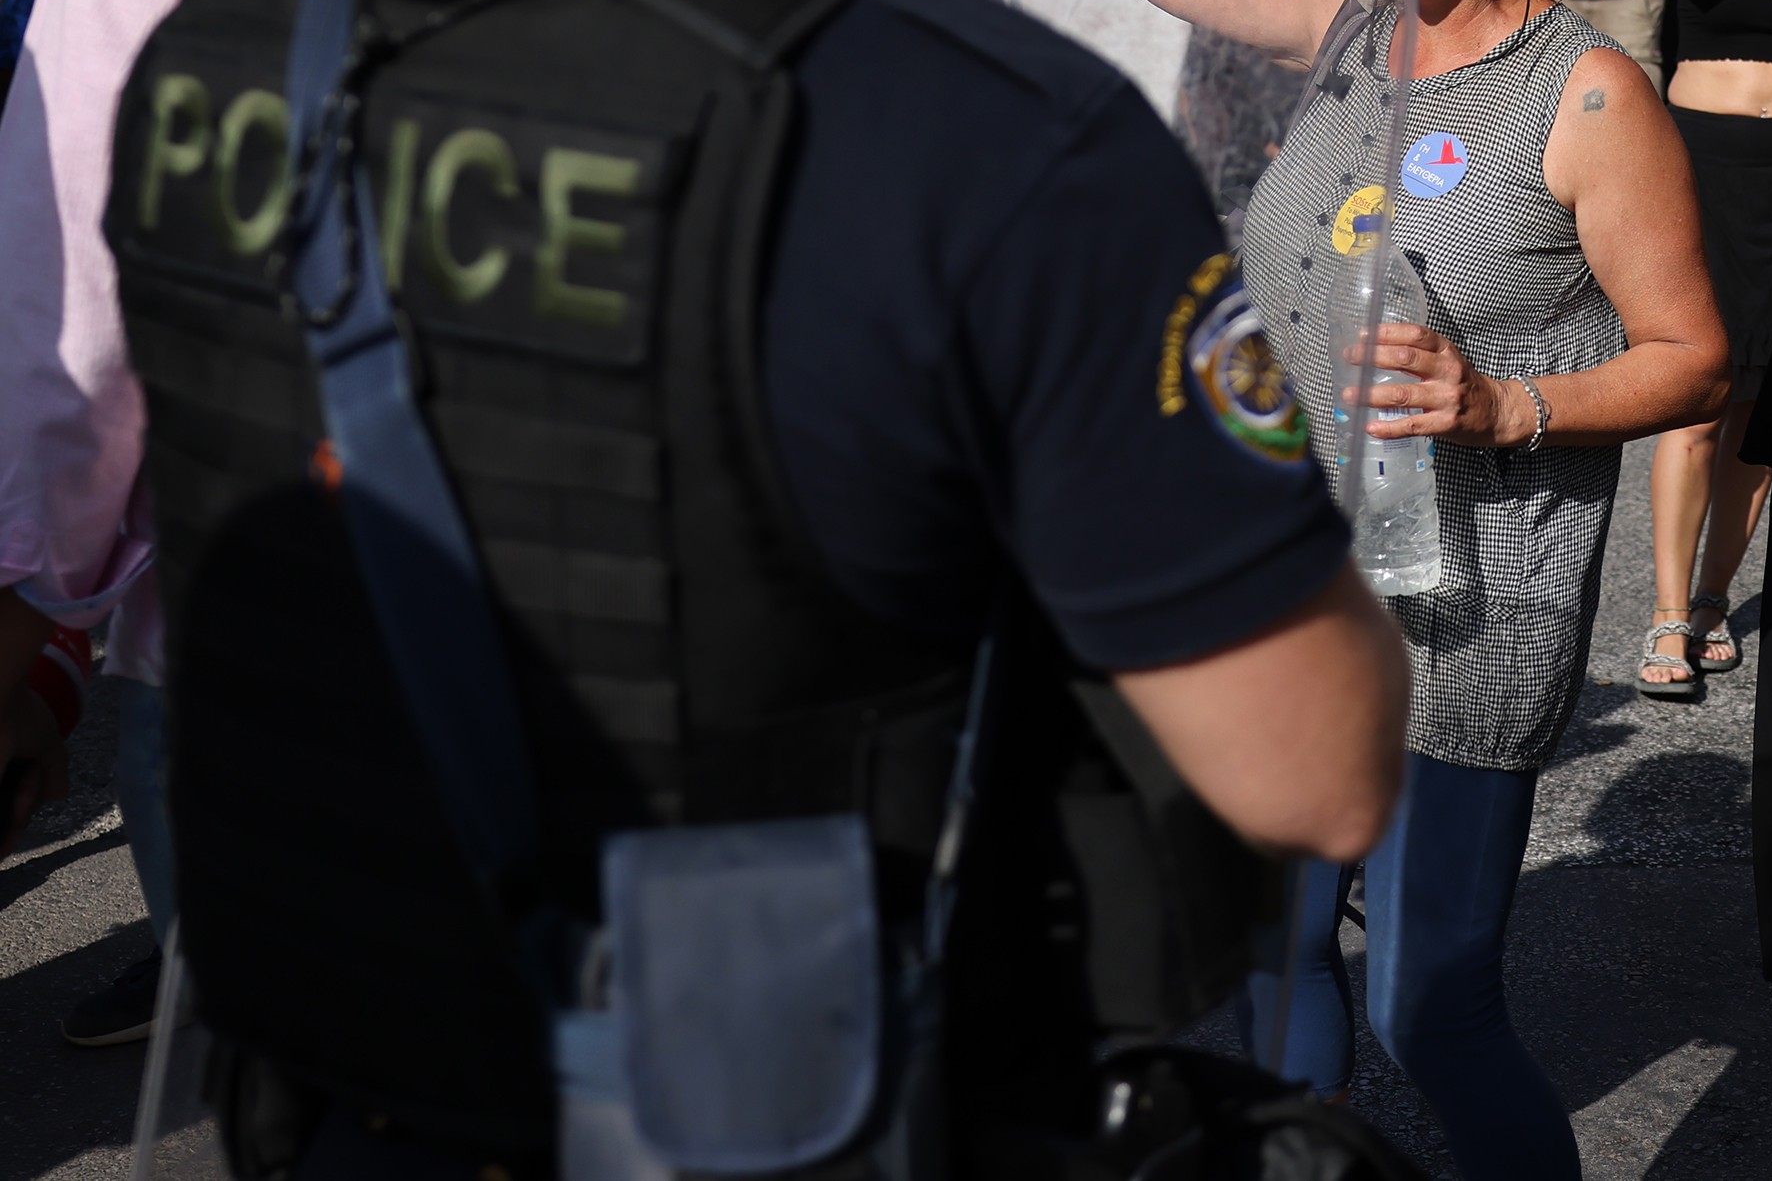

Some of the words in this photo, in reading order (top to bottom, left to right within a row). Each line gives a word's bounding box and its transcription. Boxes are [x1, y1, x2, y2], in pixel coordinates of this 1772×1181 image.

[1413, 153, 1421, 162] &
[1419, 143, 1431, 154] ΓΗ
[1406, 162, 1445, 188] ΕΛΕΥΘΕΡΙΑ
[138, 73, 641, 322] POICE
